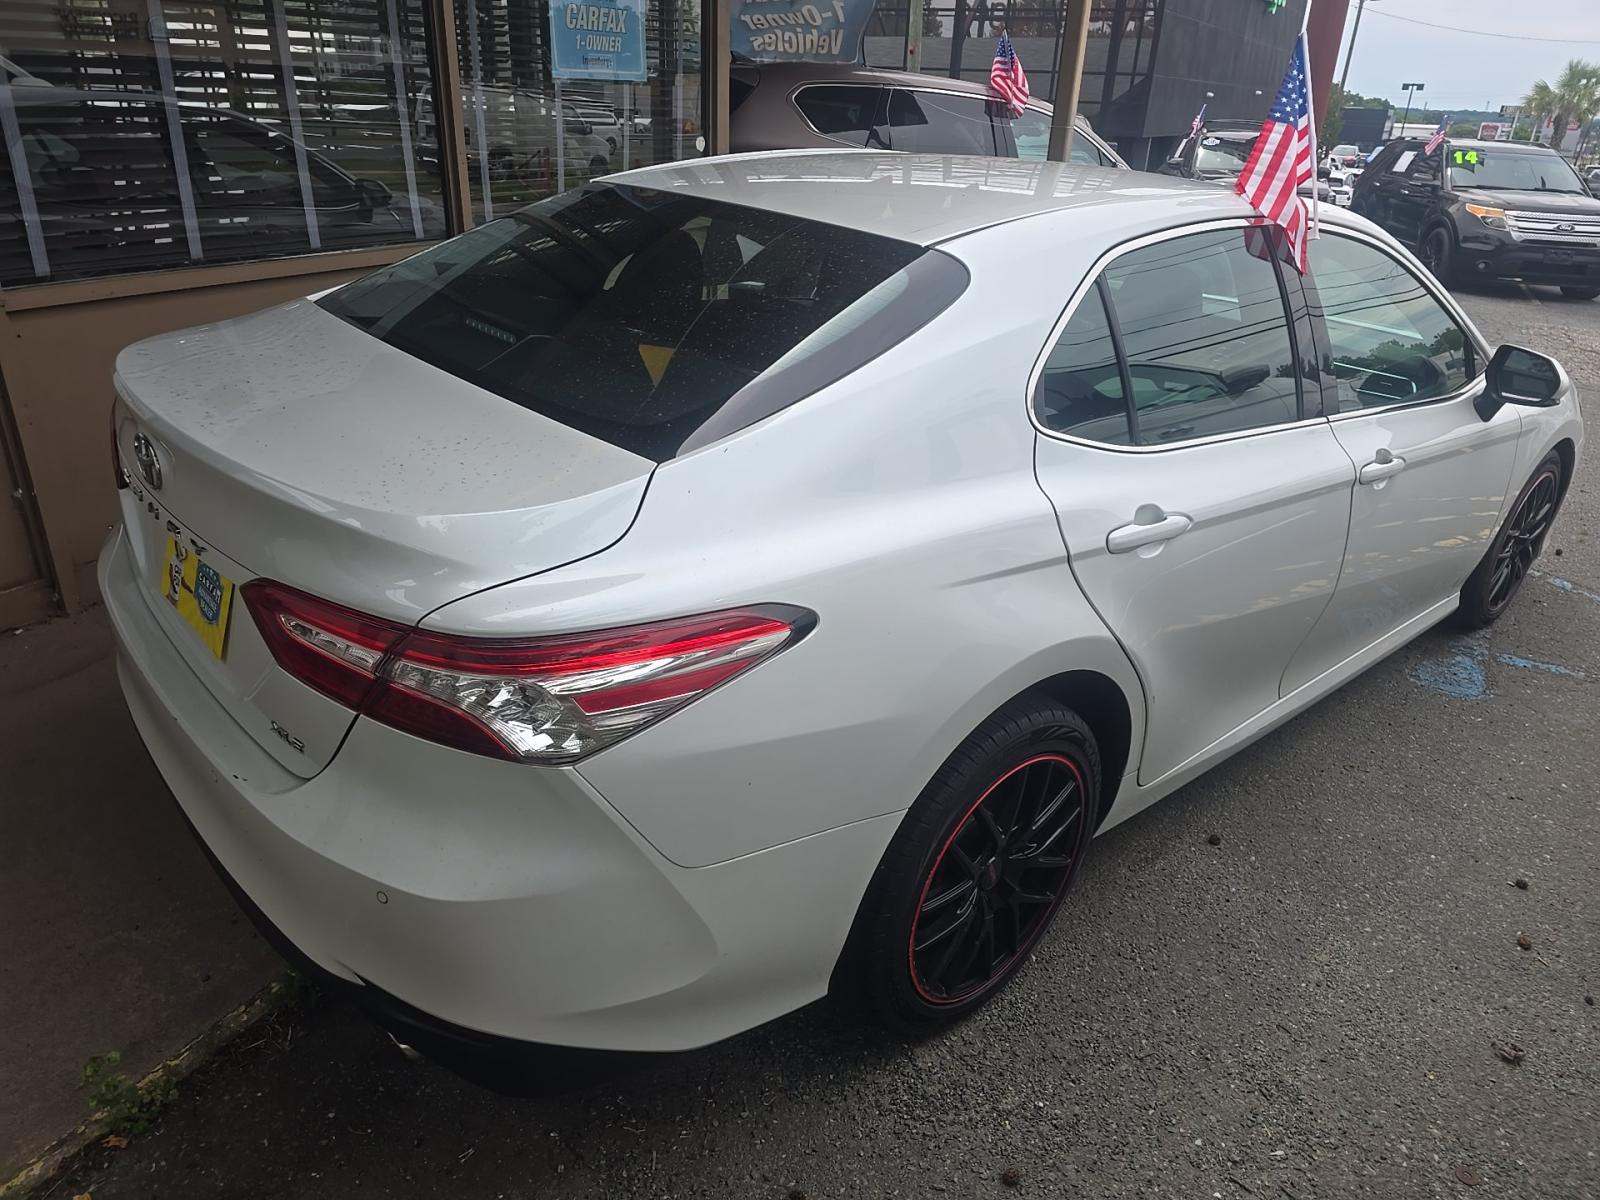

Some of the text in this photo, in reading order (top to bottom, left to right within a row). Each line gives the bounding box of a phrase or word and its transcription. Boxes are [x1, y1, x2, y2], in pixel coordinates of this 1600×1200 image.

[566, 3, 629, 33] CARFAX
[575, 34, 623, 52] 1-OWNER
[1454, 151, 1478, 164] 14
